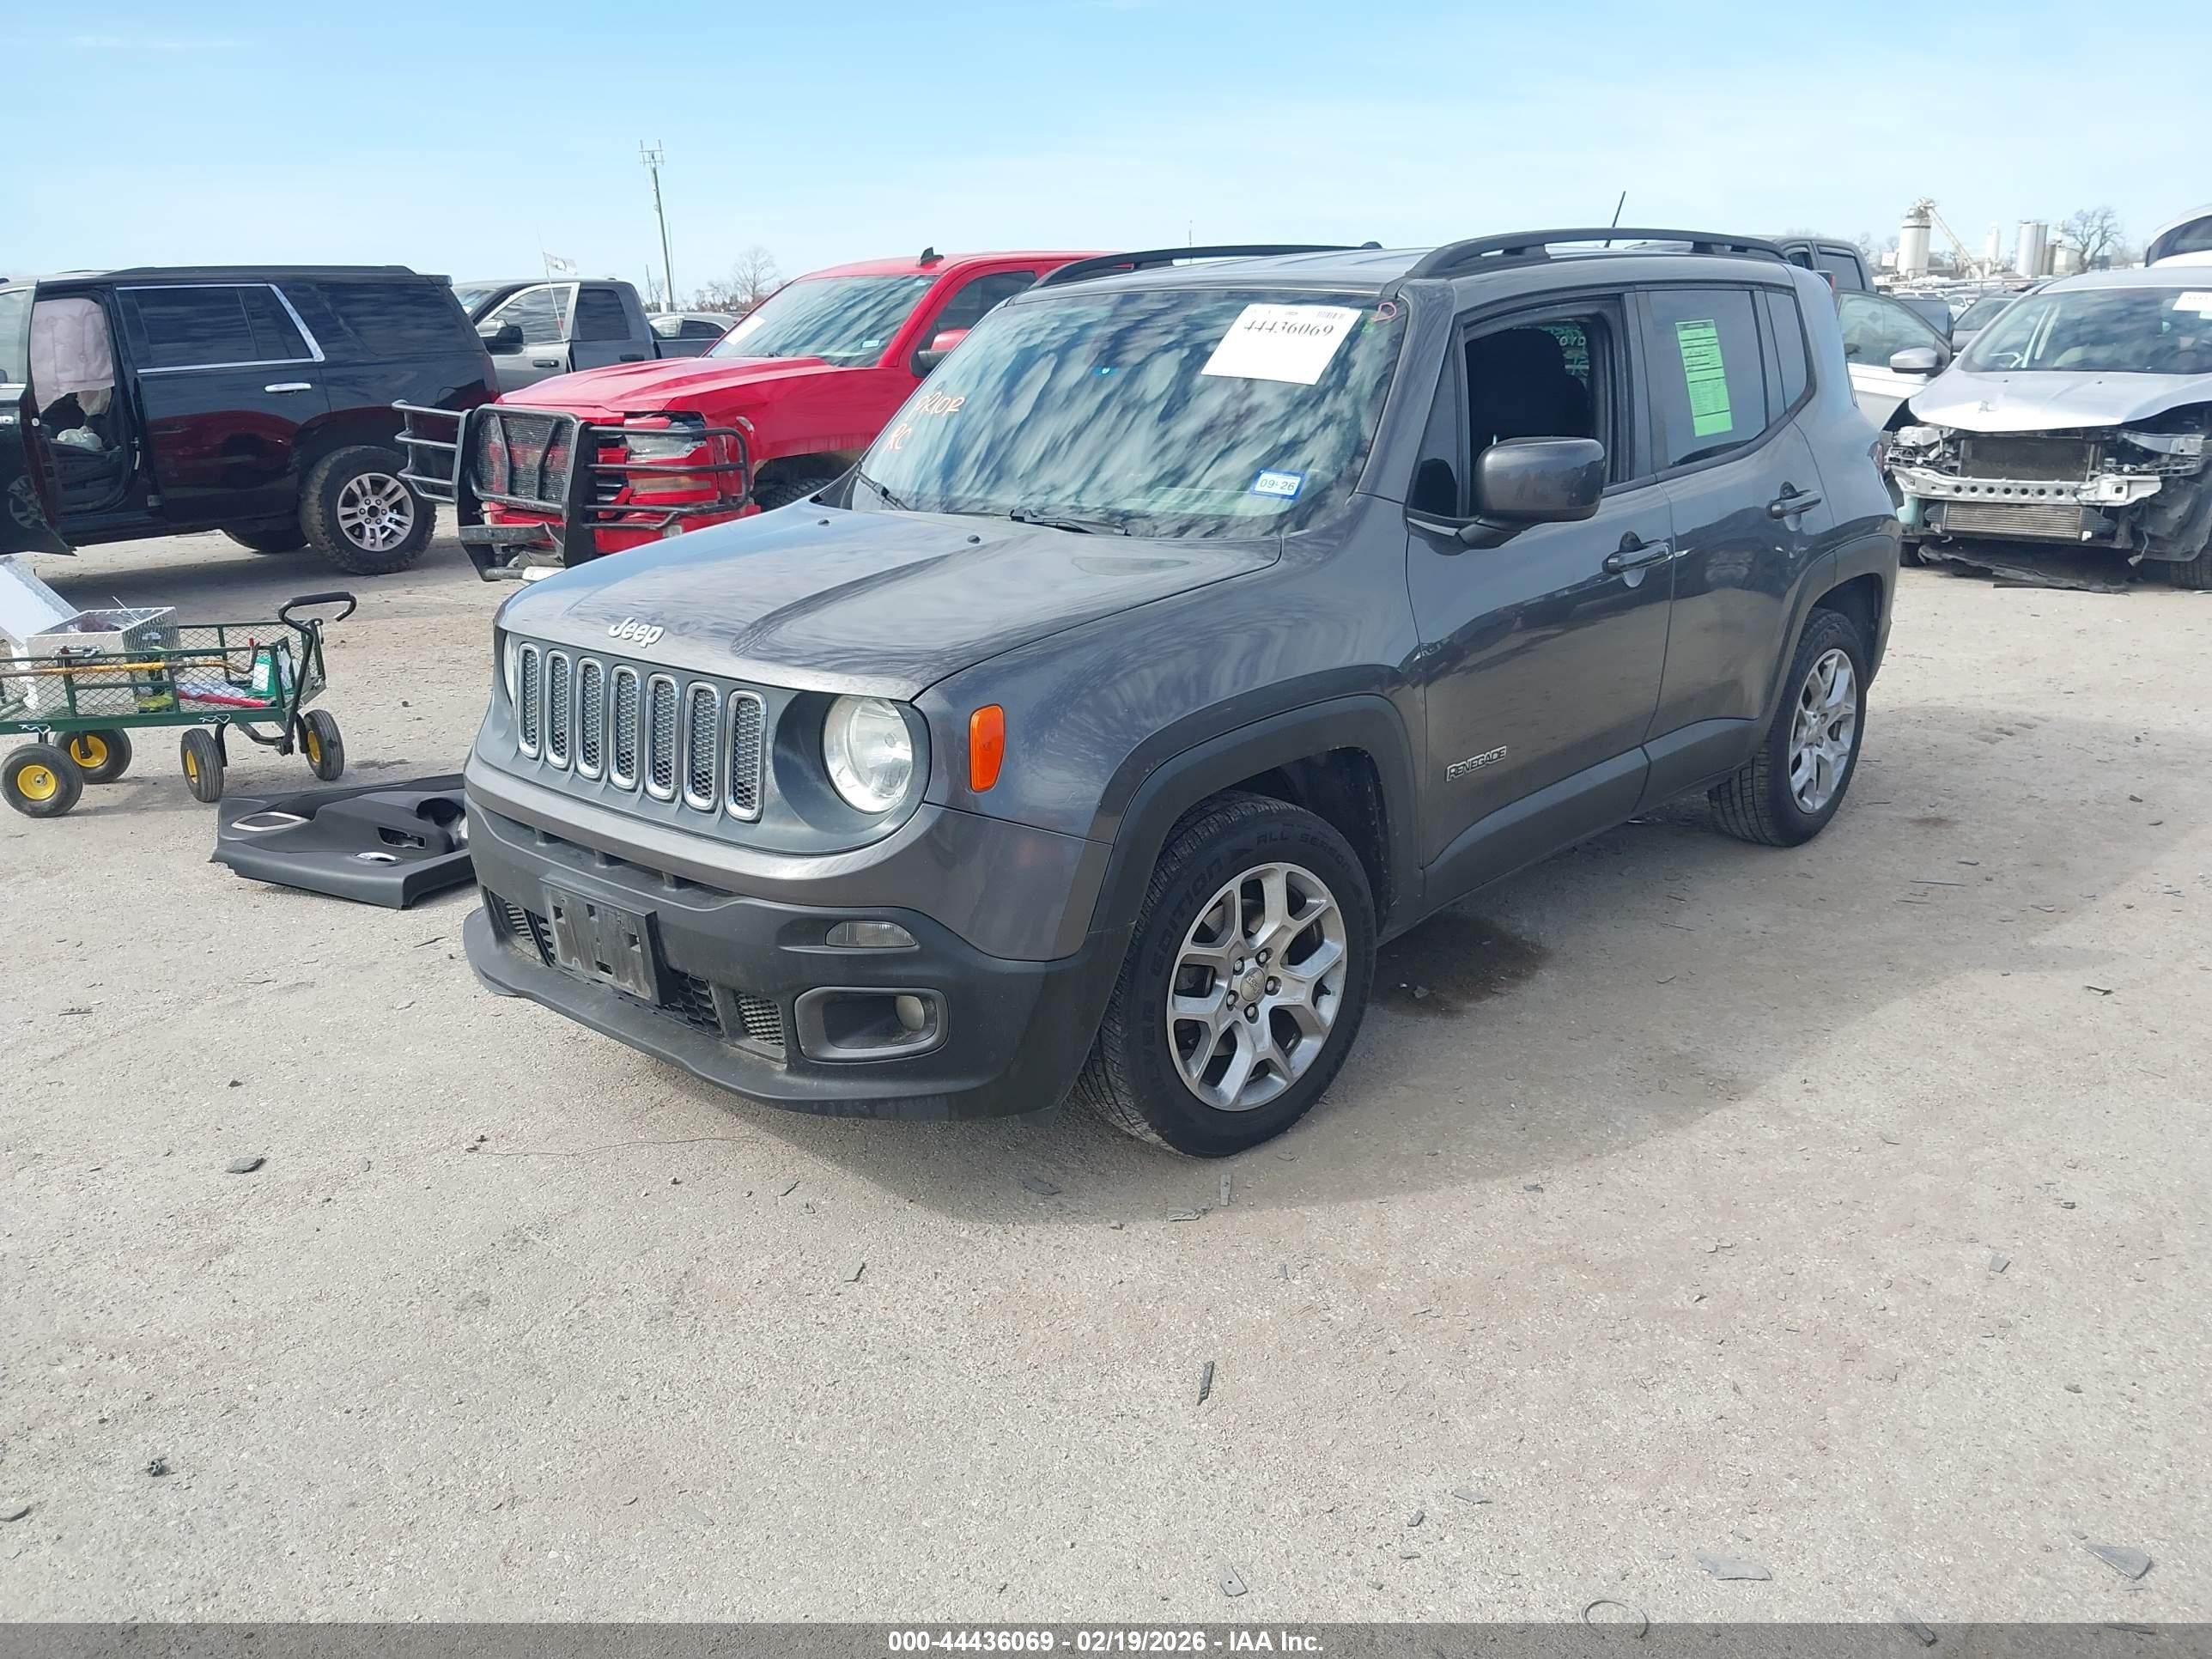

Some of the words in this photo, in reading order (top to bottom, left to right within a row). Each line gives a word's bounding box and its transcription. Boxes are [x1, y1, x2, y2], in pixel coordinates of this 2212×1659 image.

[1243, 319, 1335, 337] 44436069
[608, 617, 665, 649] Jeep
[1445, 745, 1507, 782] RENEGADE
